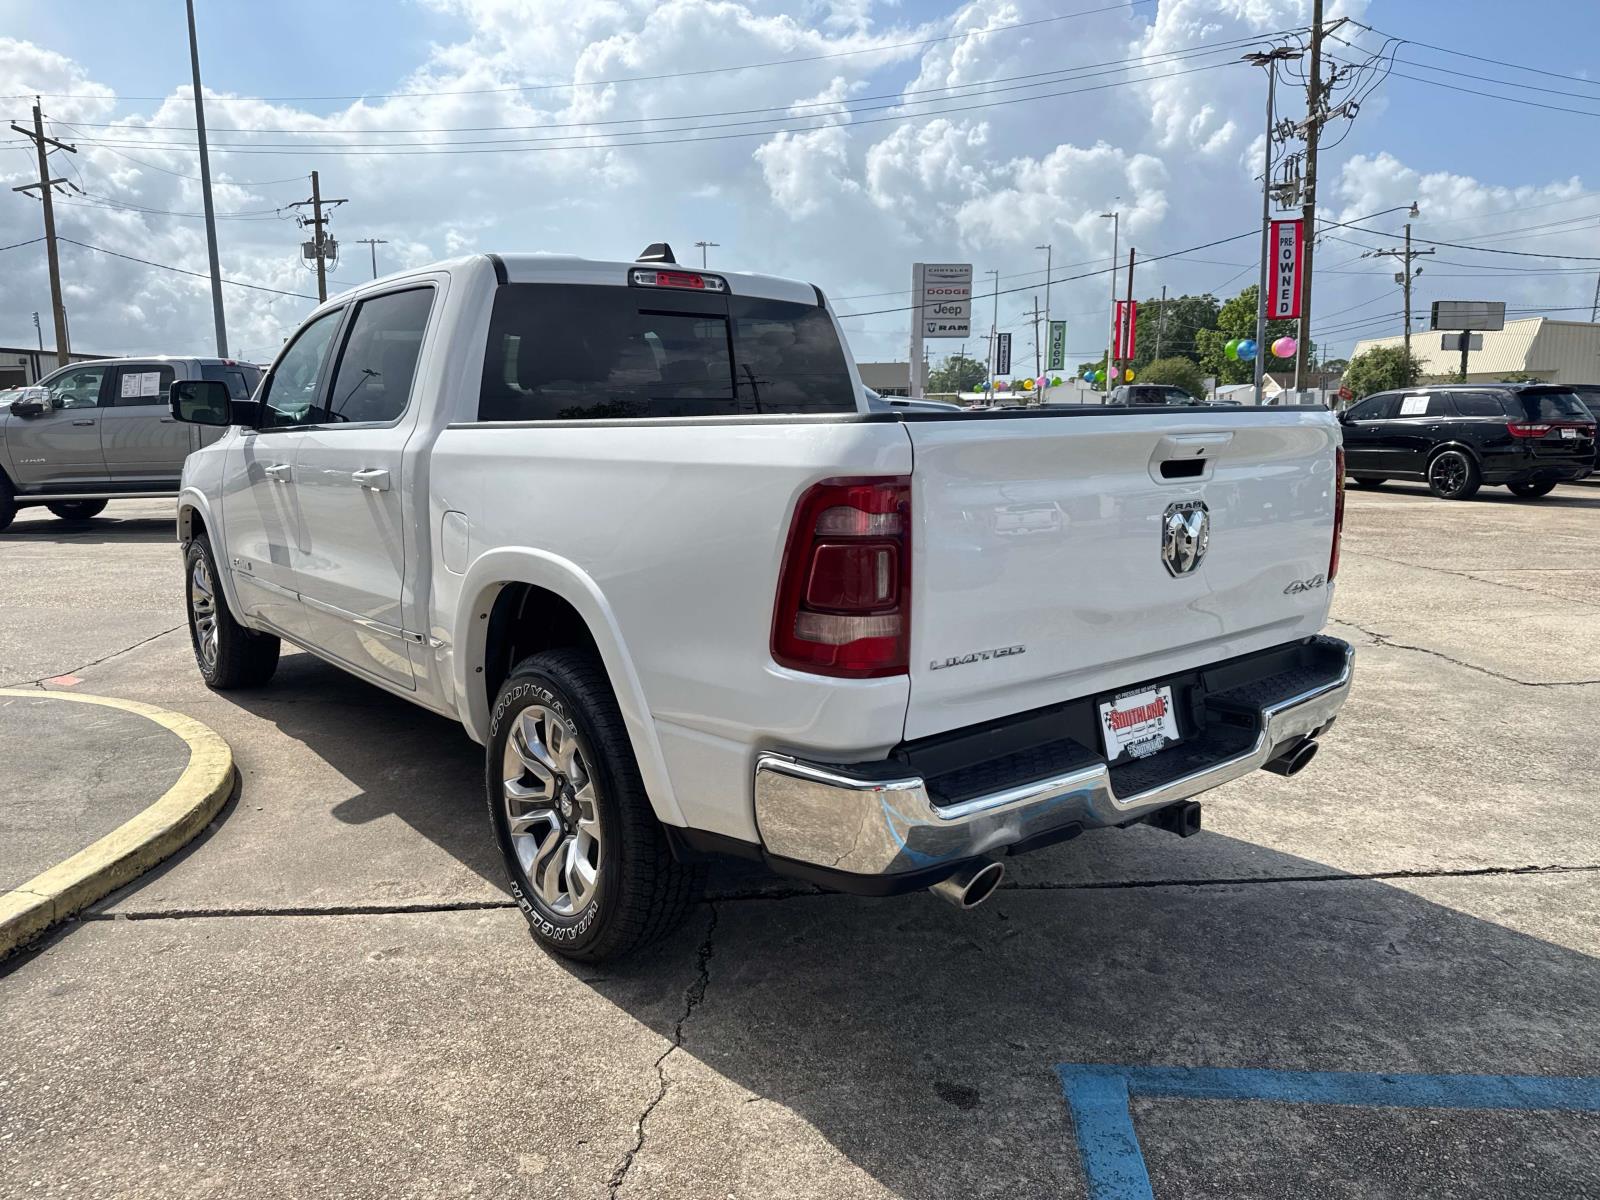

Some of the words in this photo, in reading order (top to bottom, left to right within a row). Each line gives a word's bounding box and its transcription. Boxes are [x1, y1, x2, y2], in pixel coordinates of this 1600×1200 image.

[1279, 237, 1295, 247] PRE-
[1279, 248, 1295, 314] OWNED
[933, 303, 962, 316] Jeep
[1052, 331, 1062, 367] Jeep
[1174, 501, 1203, 511] RAM
[929, 644, 1026, 671] LIMITED
[491, 683, 578, 737] GOODYEAR
[1110, 697, 1164, 732] SOUTHLAND
[510, 881, 598, 941] WRANGLER
